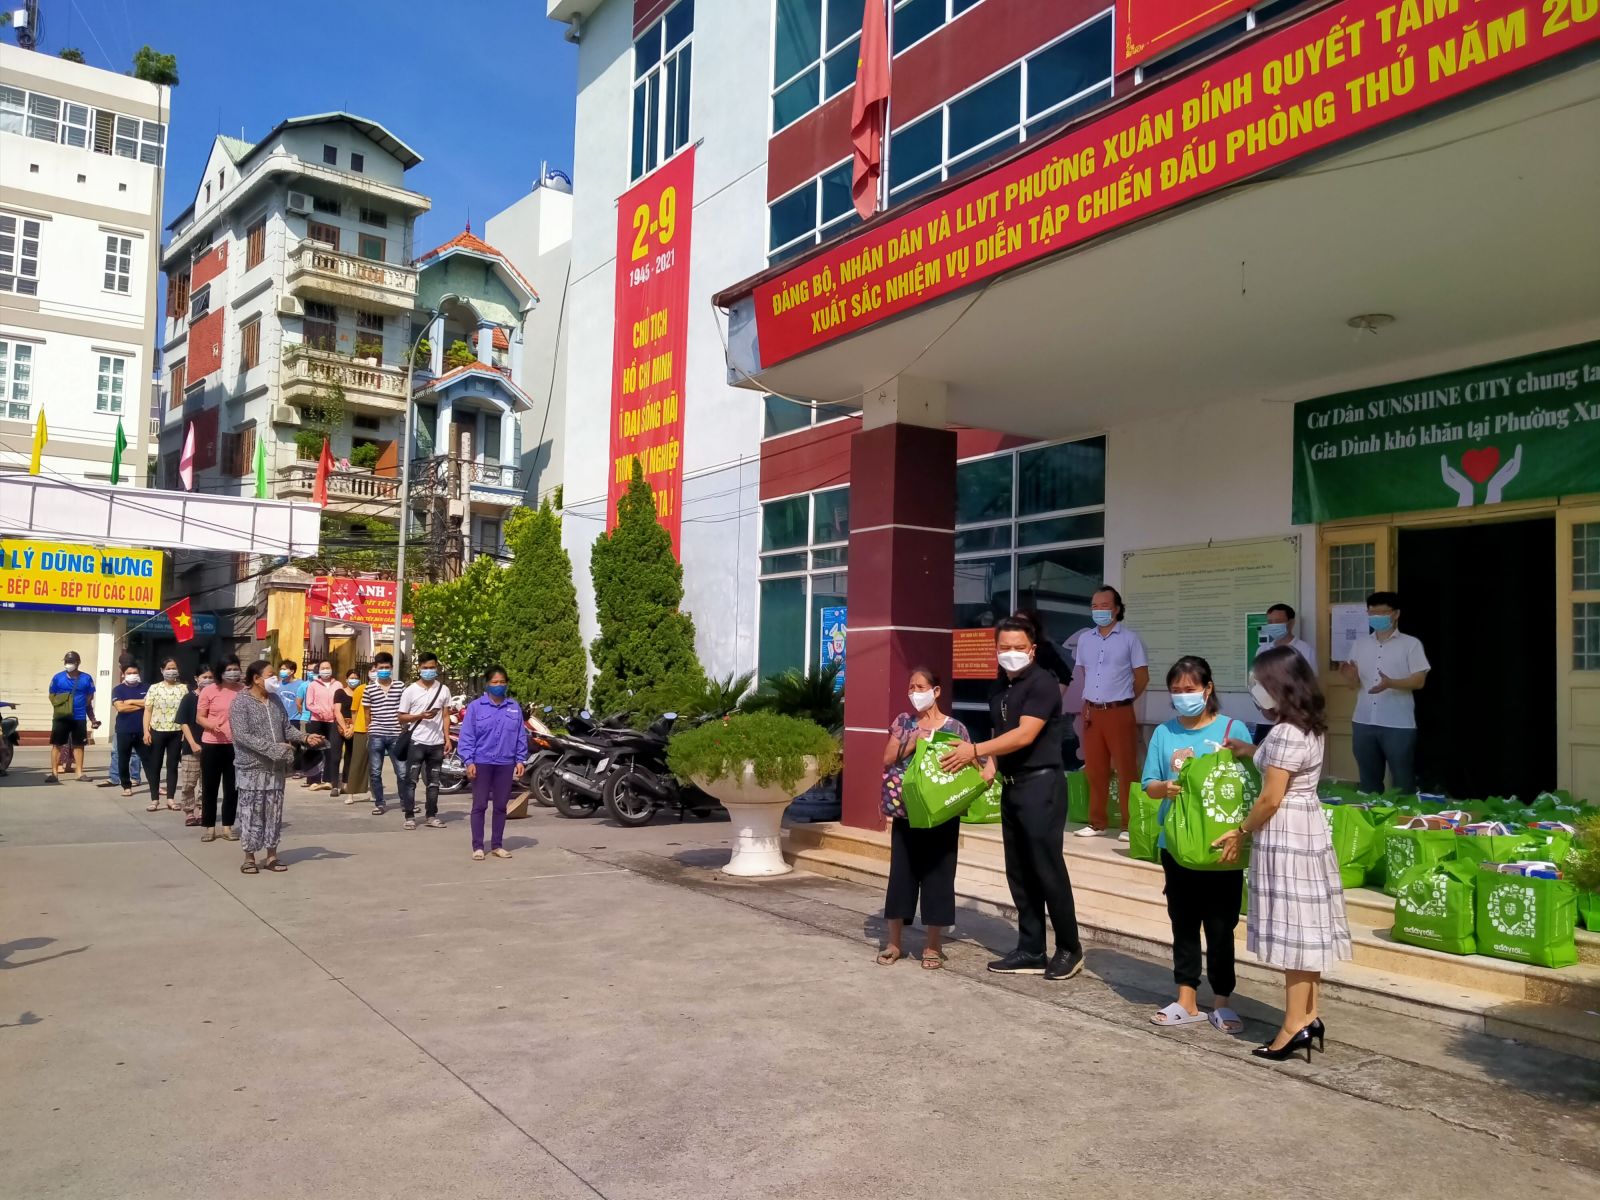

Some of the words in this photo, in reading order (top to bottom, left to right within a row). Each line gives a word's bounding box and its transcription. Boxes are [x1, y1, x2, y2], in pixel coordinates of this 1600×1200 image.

[772, 282, 809, 316] ĐẢNG
[812, 265, 836, 297] BỘ,
[840, 250, 883, 285] NHÂN
[888, 226, 922, 263] DÂN
[927, 210, 951, 245] VÀ
[956, 190, 999, 232] LLVT
[1005, 146, 1095, 212] PHƯỜNG
[1102, 109, 1173, 168] XUÂN
[1182, 72, 1252, 132] ĐỈNH
[1262, 16, 1365, 96] QUYẾT
[811, 294, 846, 334] XUẤT
[852, 282, 882, 317] SẮC
[886, 259, 941, 297] NHIỆM
[946, 246, 969, 278] VỤ
[976, 220, 1022, 268] DIỄN
[1028, 204, 1070, 244] TẬP
[1077, 164, 1152, 224] CHIẾN
[1160, 136, 1216, 192] ĐẤU
[1226, 90, 1336, 164] PHÒNG
[1346, 44, 1415, 114] THỦ
[1428, 8, 1527, 84] NĂM
[632, 186, 676, 262] 2-9
[630, 263, 650, 288] 1945
[656, 248, 675, 274] 2021
[632, 307, 650, 349] CHỦ
[650, 308, 668, 346] TỊCH
[622, 357, 637, 395] HỒ
[652, 351, 673, 385] MINH
[624, 408, 641, 442] ĐẠI
[641, 394, 661, 433] SỐNG
[662, 390, 678, 426] MÃI
[1307, 410, 1331, 430] Cư
[1332, 404, 1364, 426] Dân
[1368, 386, 1461, 420] SUNSHINE
[1463, 376, 1512, 402] CITY
[1516, 368, 1579, 394] chung
[1310, 441, 1337, 460] Gia
[1384, 426, 1417, 450] khó
[1420, 422, 1463, 445] khăn
[1467, 415, 1490, 442] tại
[1495, 406, 1571, 434] Phường
[650, 436, 680, 476] NGHIỆP
[12, 547, 34, 569] LÝ
[41, 550, 94, 573] DŨNG
[100, 556, 153, 578] HƯNG
[8, 574, 30, 595] BẾP
[34, 580, 48, 596] GA
[60, 578, 82, 598] BẾP
[104, 582, 126, 600] CÁC
[129, 586, 154, 606] LOẠI
[356, 584, 386, 598] ANH
